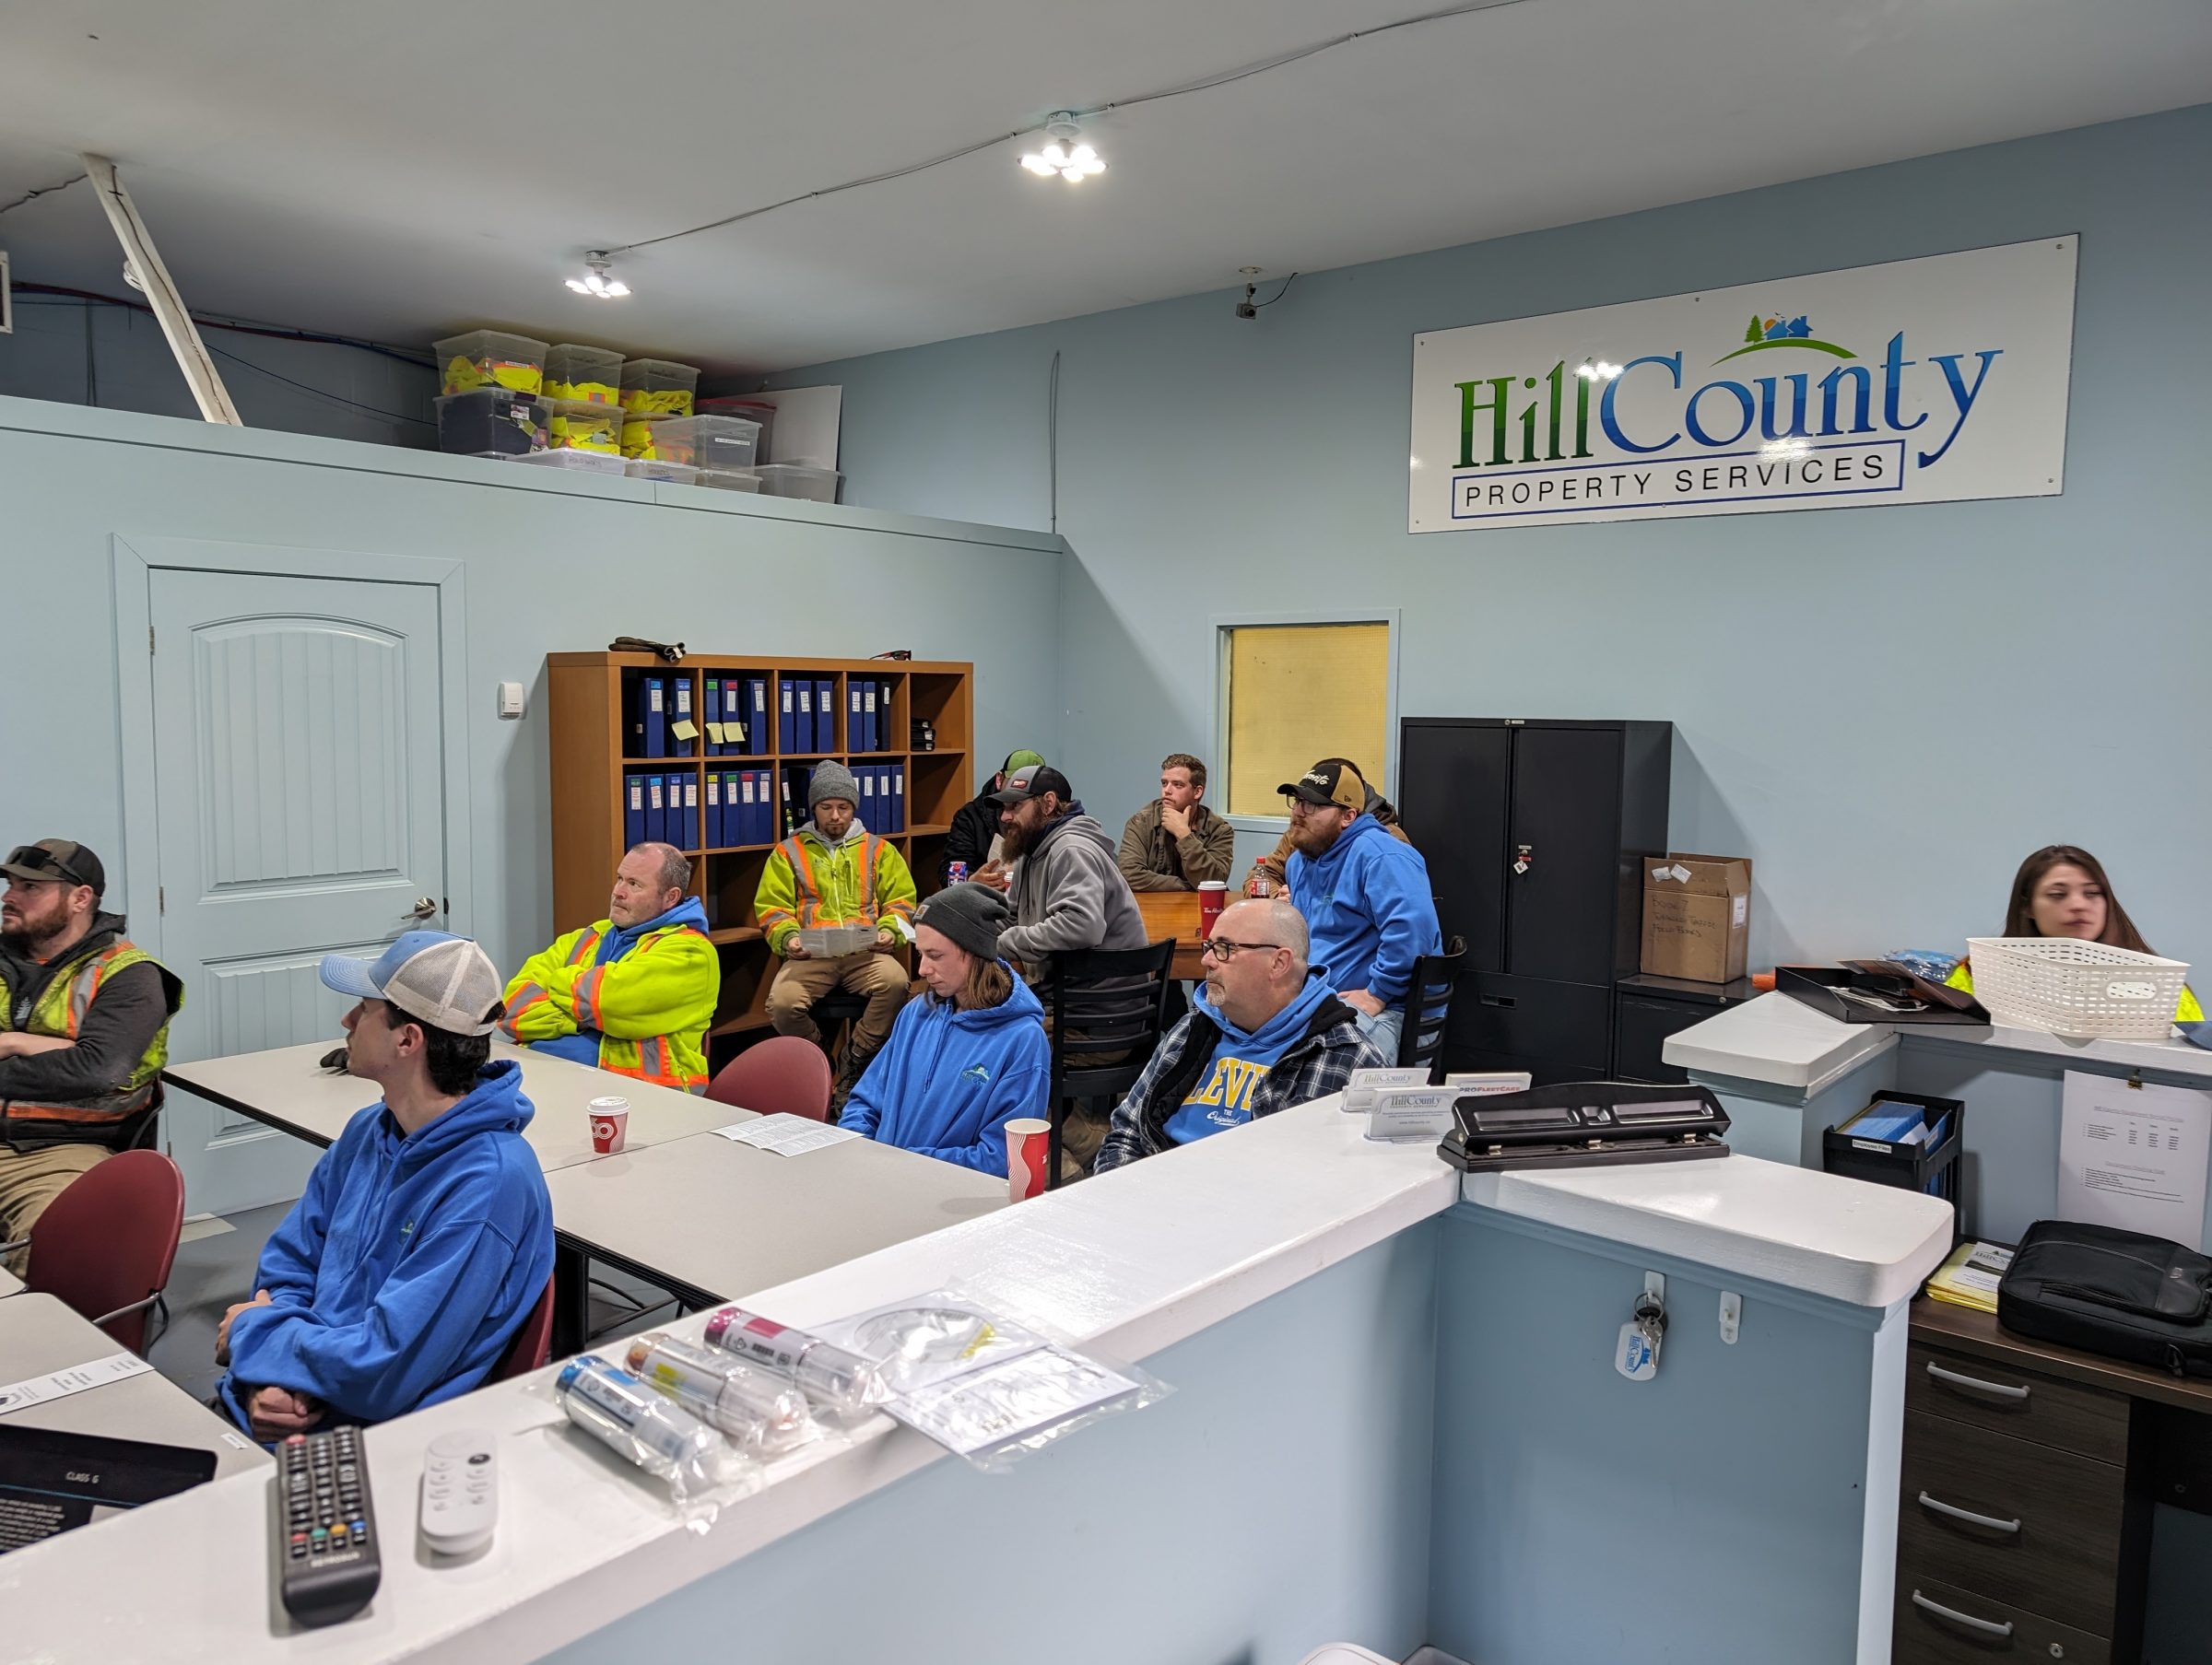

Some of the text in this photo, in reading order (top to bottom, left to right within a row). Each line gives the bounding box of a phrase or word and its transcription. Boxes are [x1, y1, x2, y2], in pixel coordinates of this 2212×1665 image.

[1452, 330, 2004, 469] HillCounty
[1465, 453, 1886, 508] PROPERTY SERVICES
[1182, 1057, 1271, 1111] LEVI
[1364, 1073, 1411, 1083] HillCounty
[1206, 1110, 1241, 1126] Original
[1391, 1094, 1441, 1107] HillCounty
